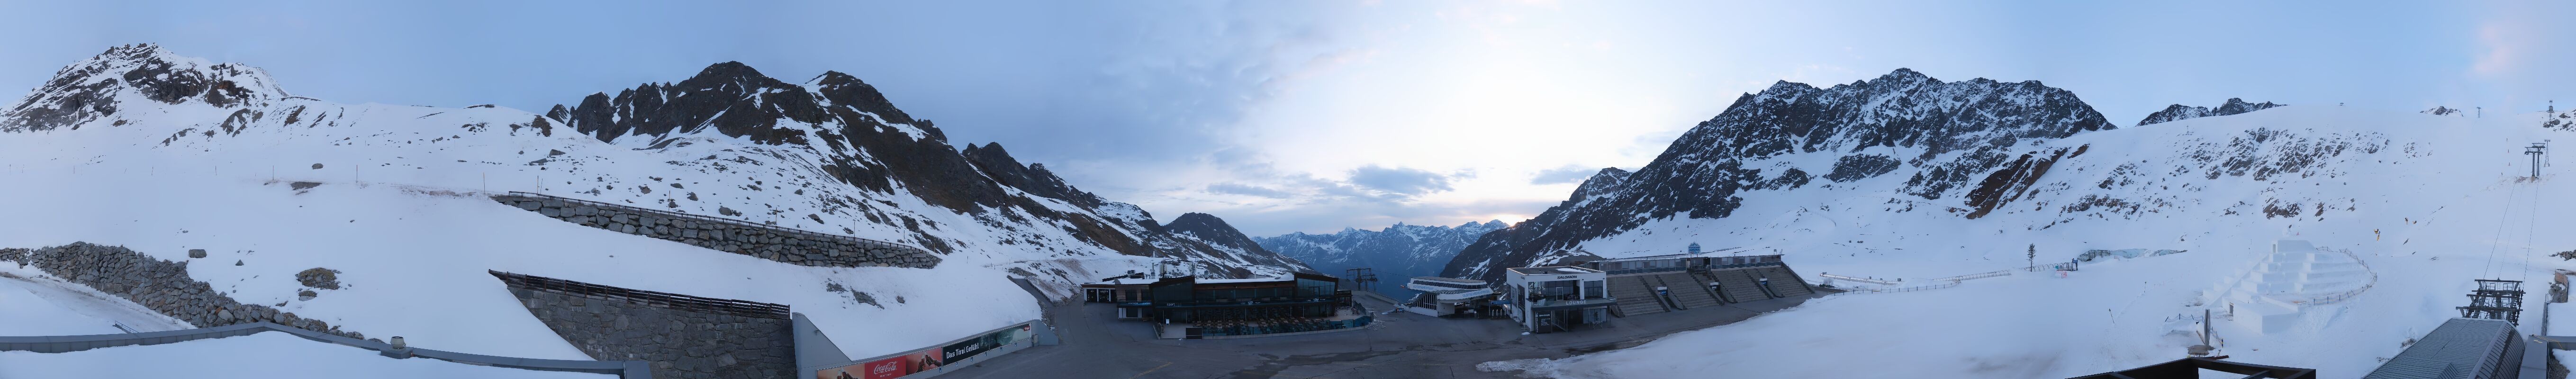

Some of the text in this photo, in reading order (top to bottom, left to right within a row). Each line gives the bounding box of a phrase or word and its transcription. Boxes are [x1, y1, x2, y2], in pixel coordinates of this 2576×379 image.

[955, 346, 966, 356] Tirol
[966, 343, 979, 353] Gefühl
[874, 361, 898, 374] Coca-Cola
